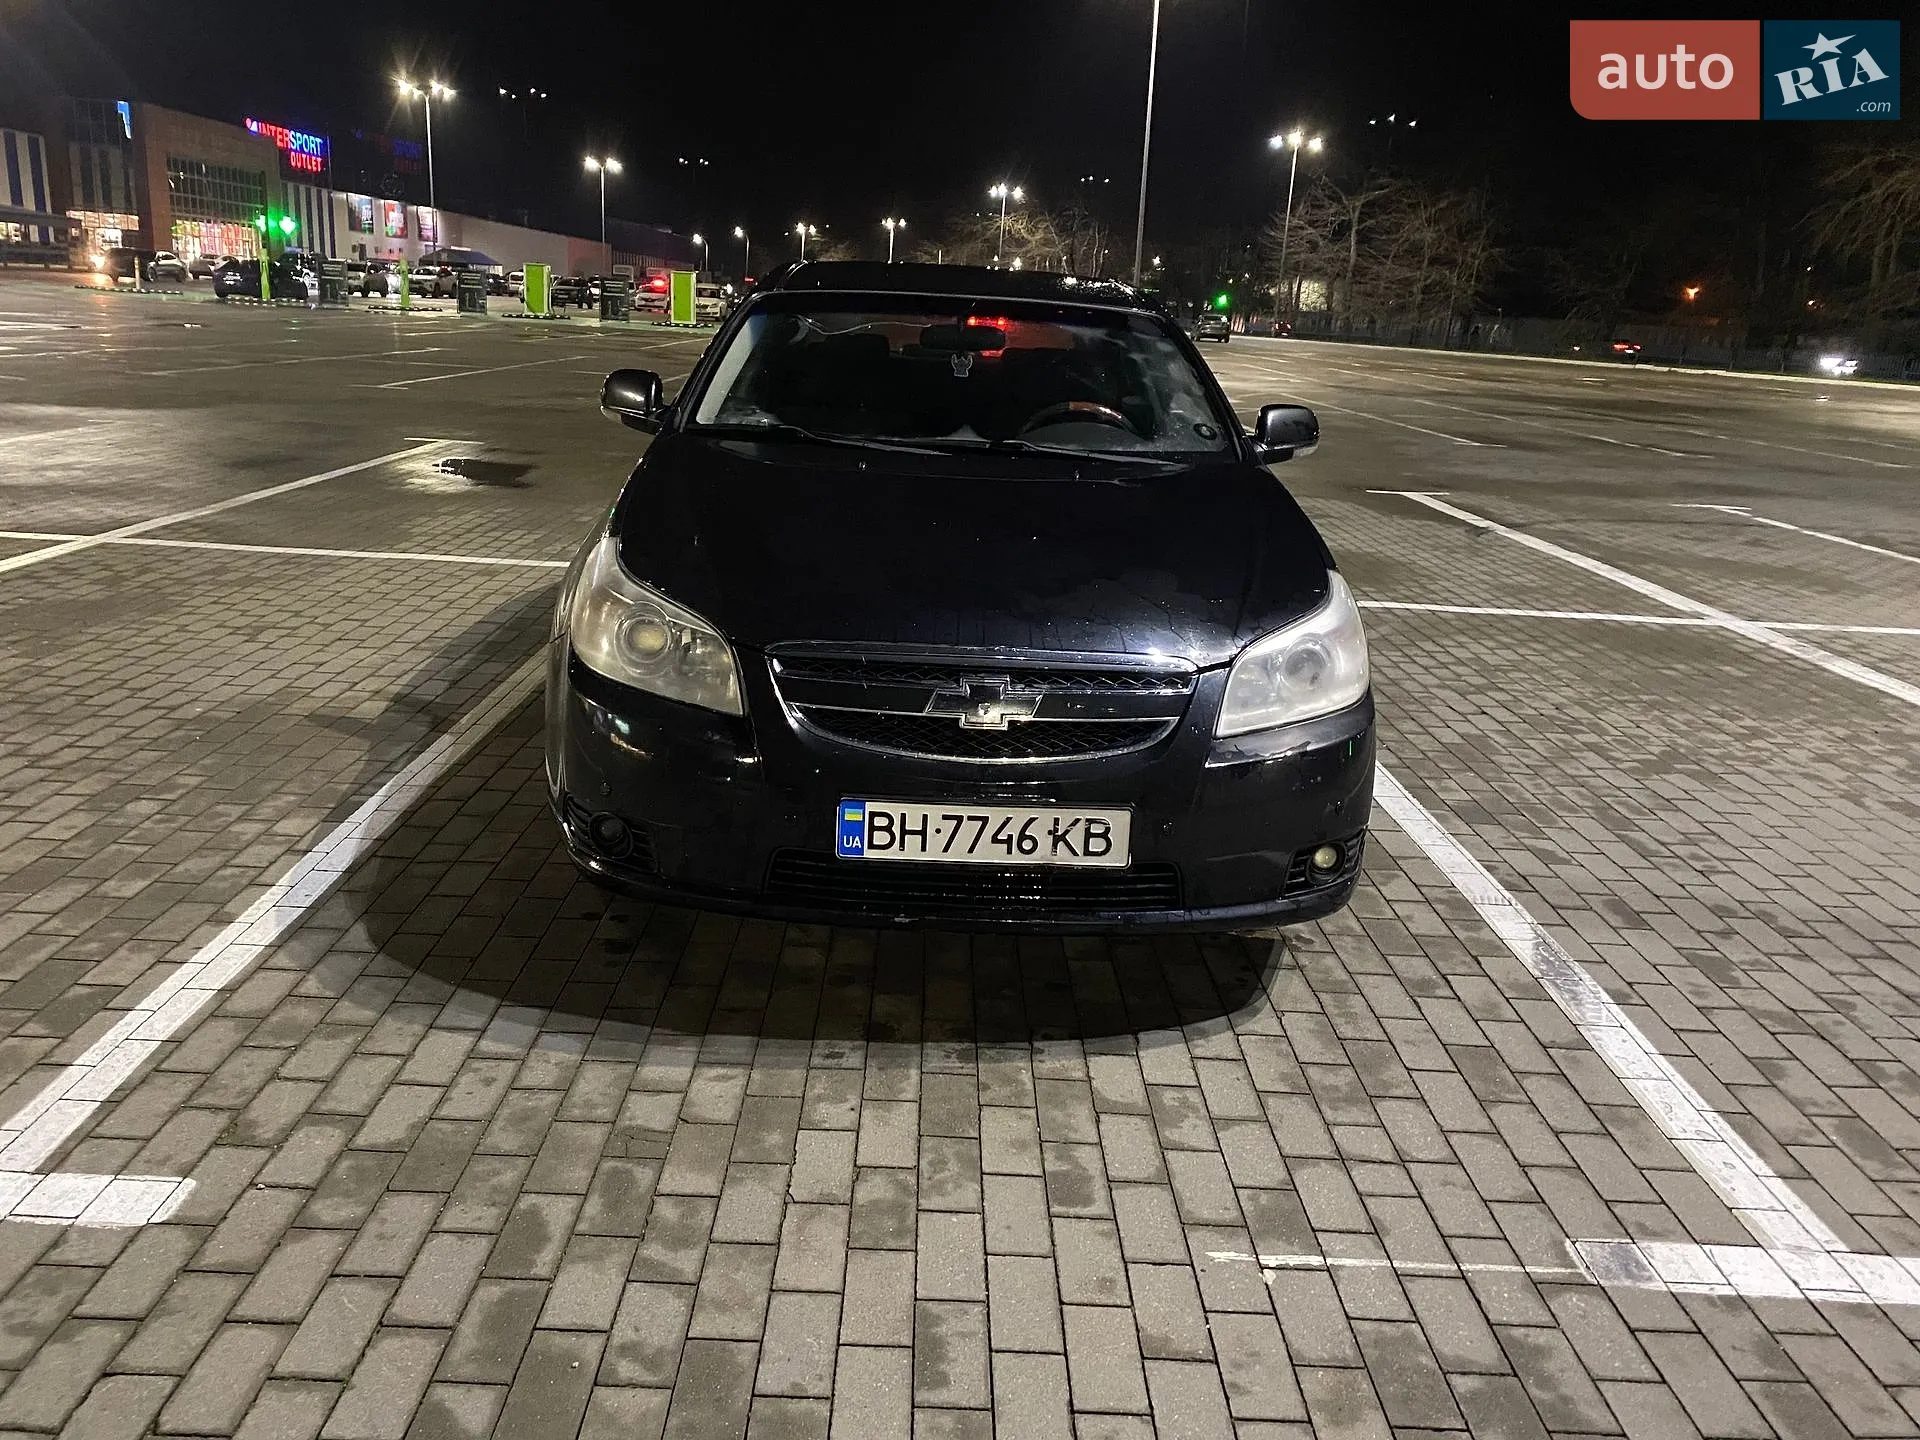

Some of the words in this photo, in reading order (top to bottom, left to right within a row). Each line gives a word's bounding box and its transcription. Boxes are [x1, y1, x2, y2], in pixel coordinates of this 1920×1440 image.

[258, 121, 324, 156] INTERSPORT
[290, 151, 323, 172] OUTLET
[843, 835, 862, 849] UA
[867, 810, 929, 852] BH
[941, 813, 1039, 856] 7746
[1052, 817, 1113, 857] KB
